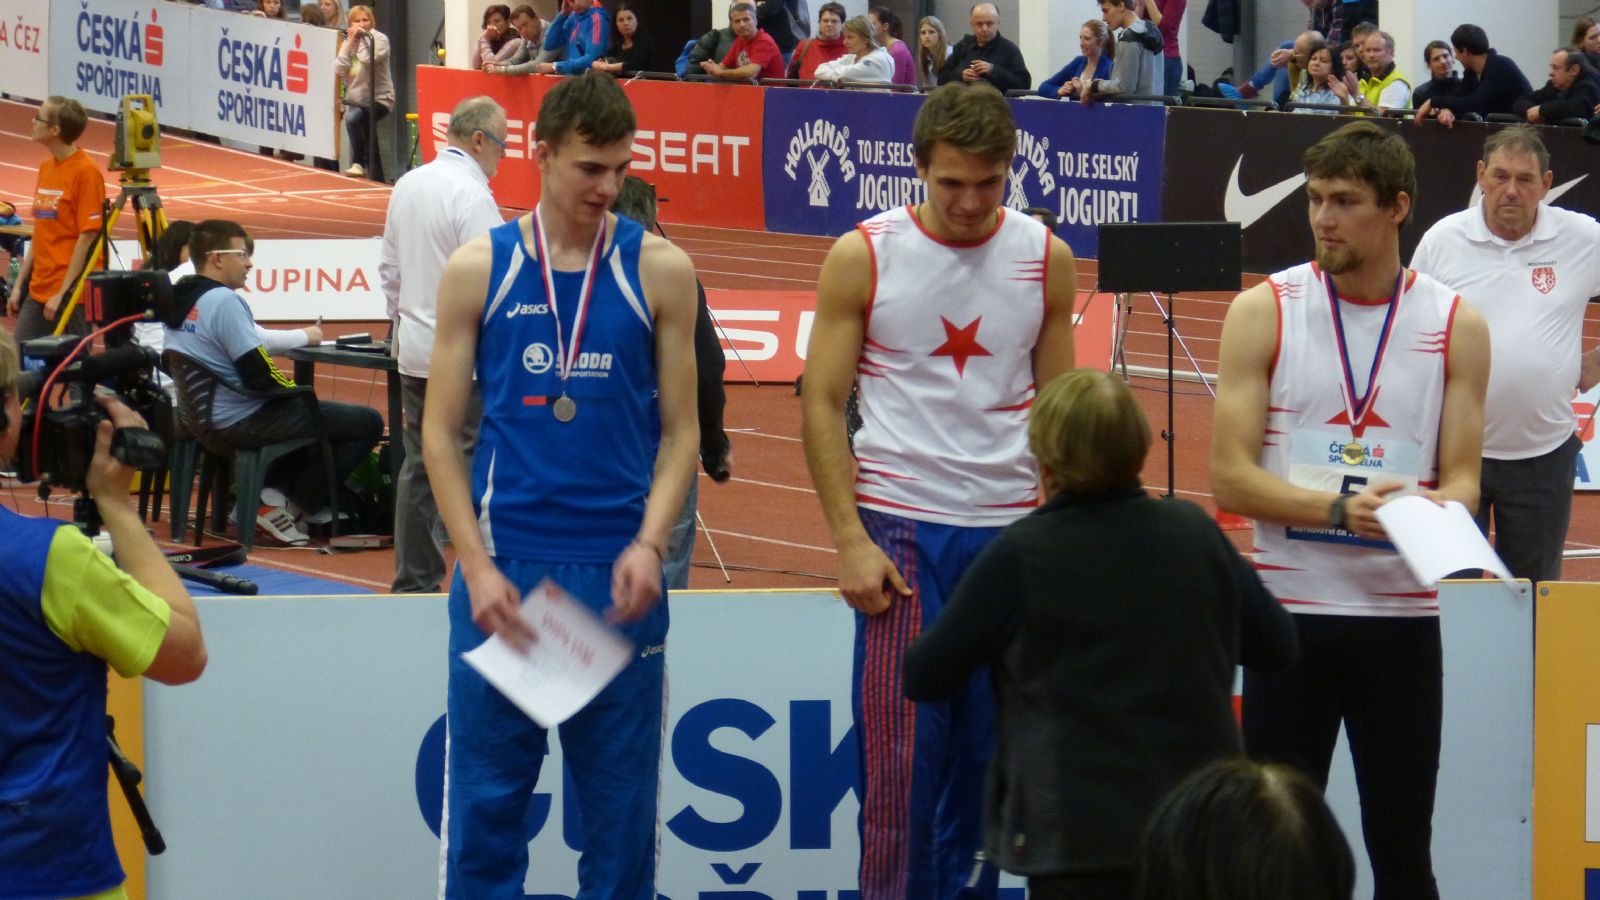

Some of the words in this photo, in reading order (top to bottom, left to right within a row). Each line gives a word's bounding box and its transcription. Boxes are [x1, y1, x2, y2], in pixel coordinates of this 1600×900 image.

[14, 16, 41, 53] ČEZ
[76, 1, 143, 62] ČESKÁ
[217, 27, 284, 90] ČESKÁ
[217, 86, 307, 137] SPOŘITELNA
[629, 130, 749, 177] SEAT
[857, 139, 872, 164] TO
[873, 140, 885, 165] JE
[886, 142, 916, 168] SELS
[1057, 151, 1074, 177] TO
[1075, 152, 1090, 179] JE
[1091, 151, 1139, 182] SELSKÝ
[1057, 187, 1138, 225] JOGURT!
[243, 267, 370, 293] UPINA
[556, 351, 613, 370] ODA
